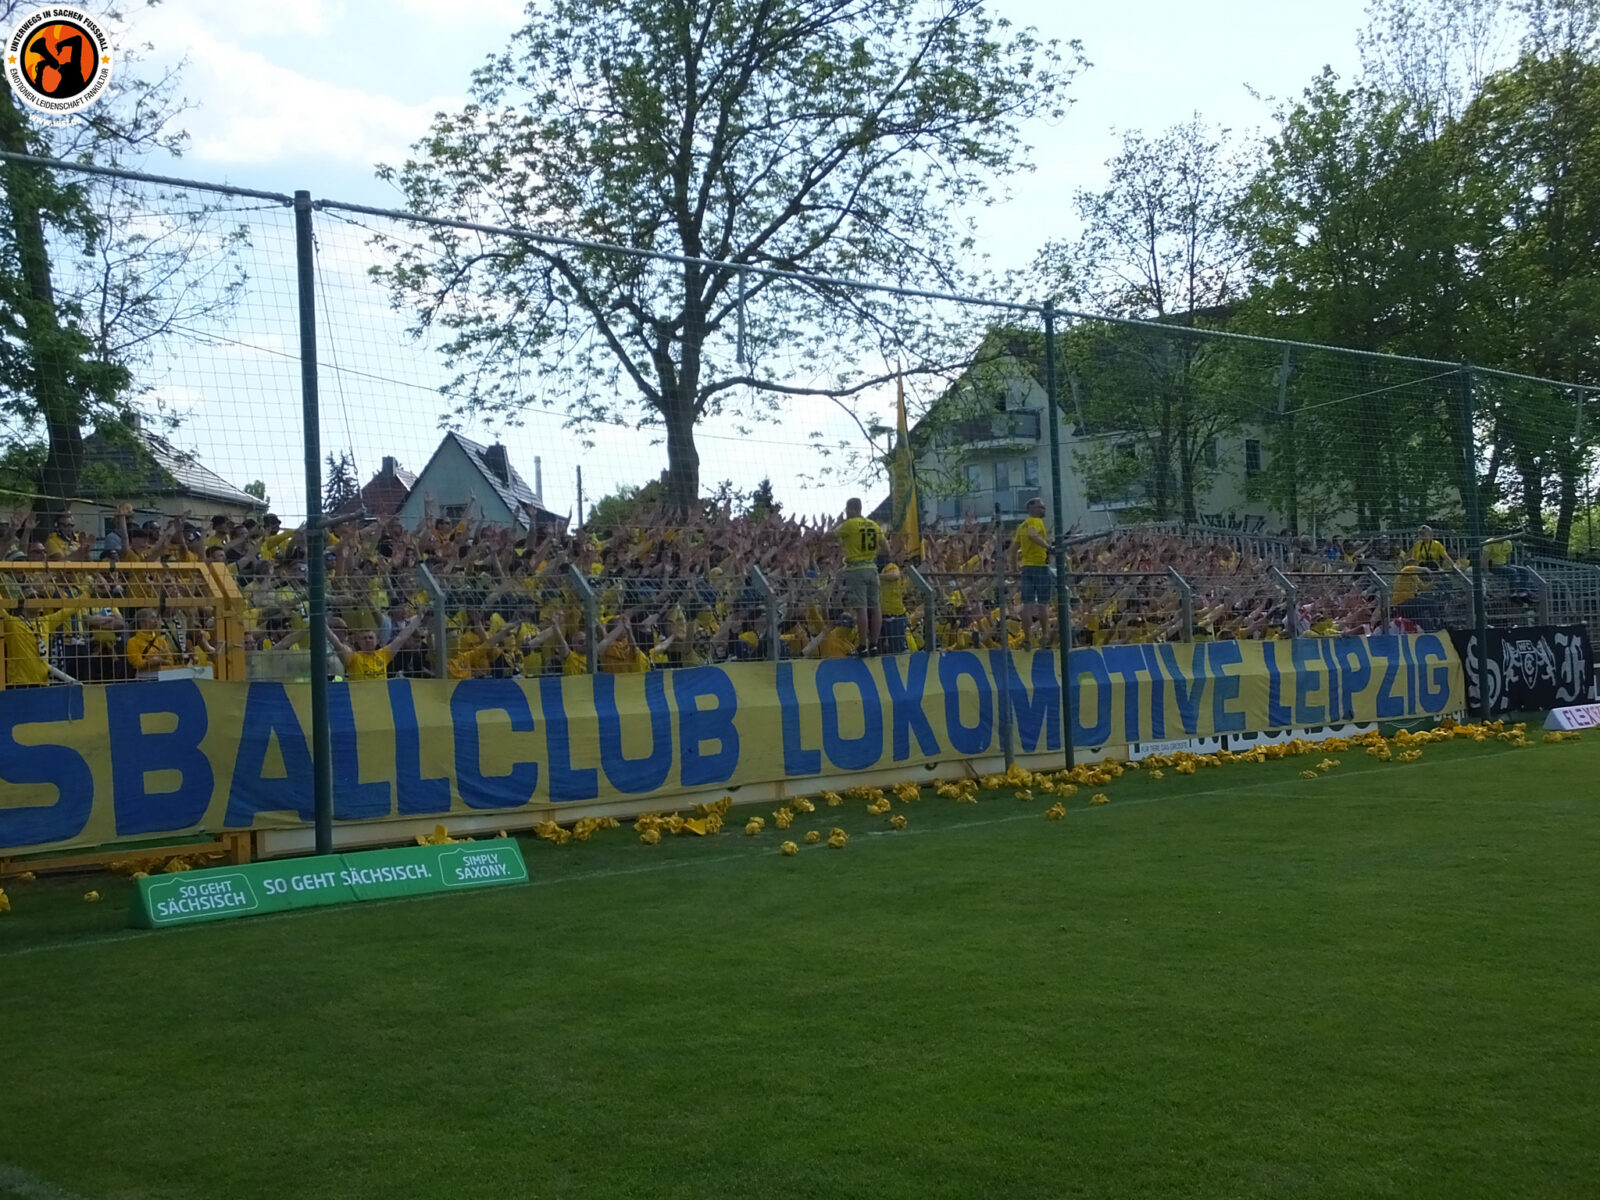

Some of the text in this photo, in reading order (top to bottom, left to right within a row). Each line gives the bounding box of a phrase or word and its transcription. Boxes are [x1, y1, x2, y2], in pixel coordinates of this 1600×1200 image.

[859, 528, 877, 552] 13
[776, 640, 1247, 776] LOKOMOTIVE
[1263, 633, 1450, 727] LEIPZIG
[455, 862, 511, 880] SAXONY.
[462, 852, 499, 866] SIMPLY
[179, 880, 232, 898] SO GEHT
[263, 863, 432, 895] SO GEHT SÄCHSISCH.
[157, 891, 246, 916] SÄCHSISCH
